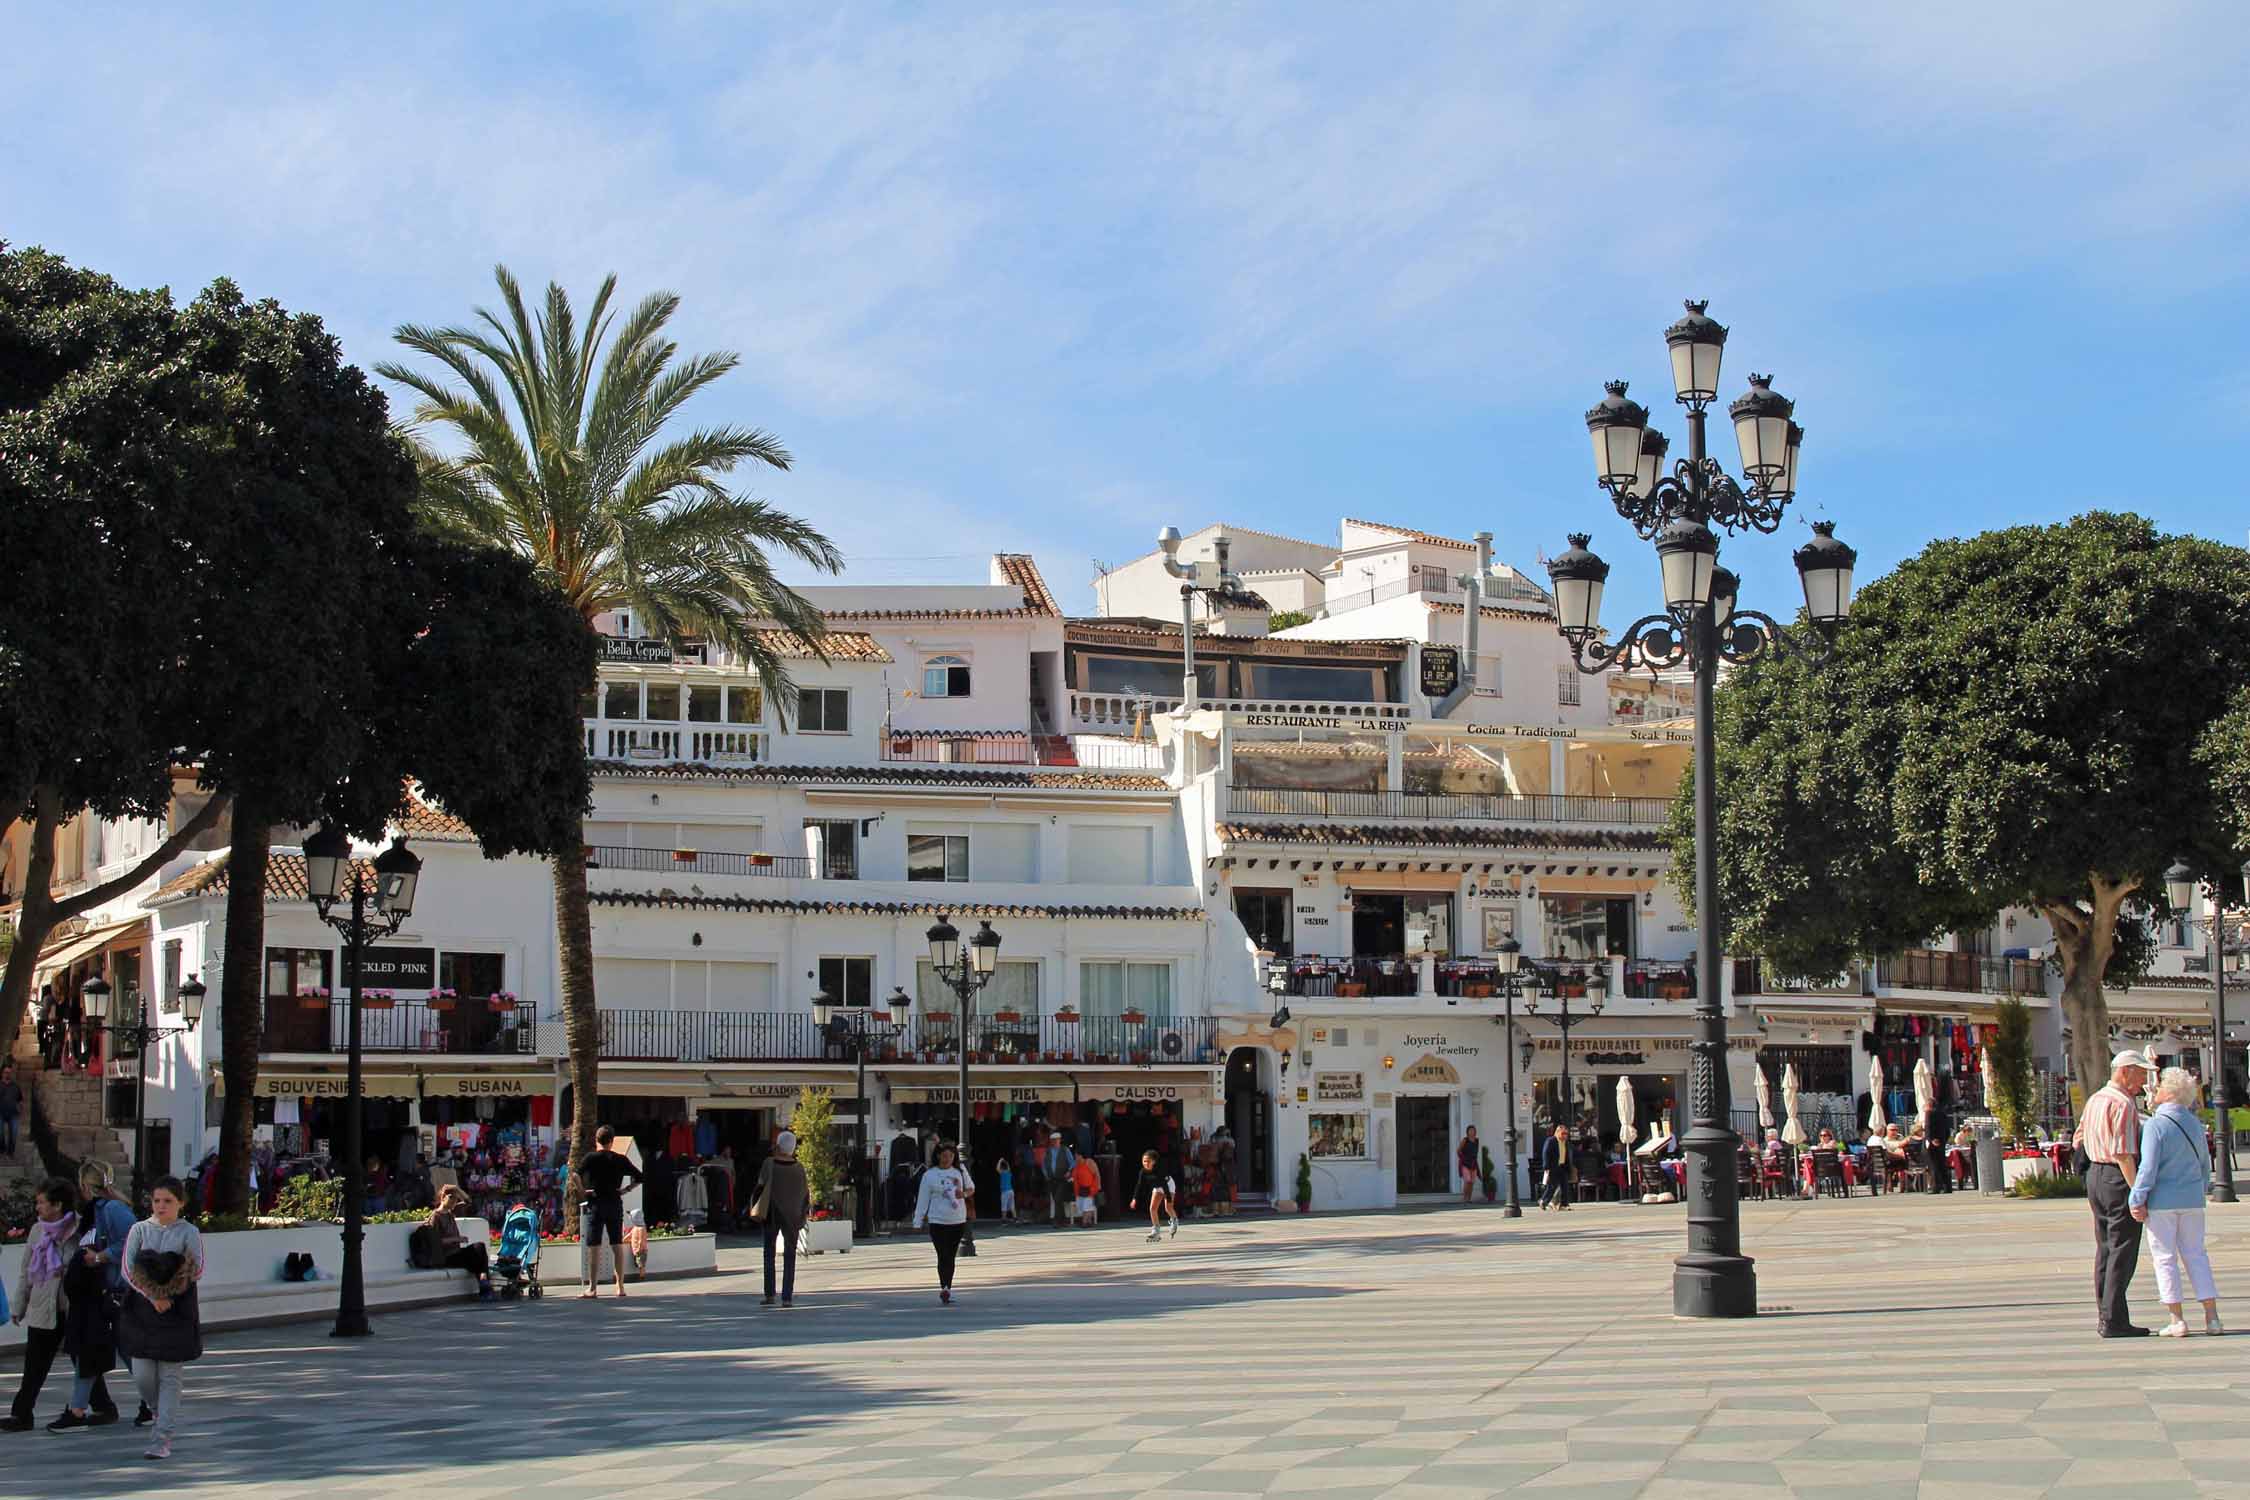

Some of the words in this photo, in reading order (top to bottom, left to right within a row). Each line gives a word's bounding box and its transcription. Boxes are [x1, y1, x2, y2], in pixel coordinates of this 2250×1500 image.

[607, 640, 632, 656] Bella
[1247, 714, 1341, 729] RESTAURANTE
[1467, 724, 1505, 735] Cocina
[1513, 725, 1577, 738] Tradicional
[1631, 729, 1660, 741] Steak
[1666, 731, 1694, 742] Hous
[401, 963, 428, 974] PINK
[2119, 1014, 2155, 1025] Lemon
[2158, 1015, 2182, 1025] Tree
[1436, 1046, 1480, 1056] Jewellery
[1567, 1040, 1641, 1050] RESTAURANTE
[458, 1080, 523, 1093] SUSANA
[749, 1085, 800, 1096] CALZADOS
[1115, 1087, 1176, 1098] CALISYO
[927, 1088, 997, 1101] ANDAUCIA
[1010, 1088, 1040, 1101] PIEL
